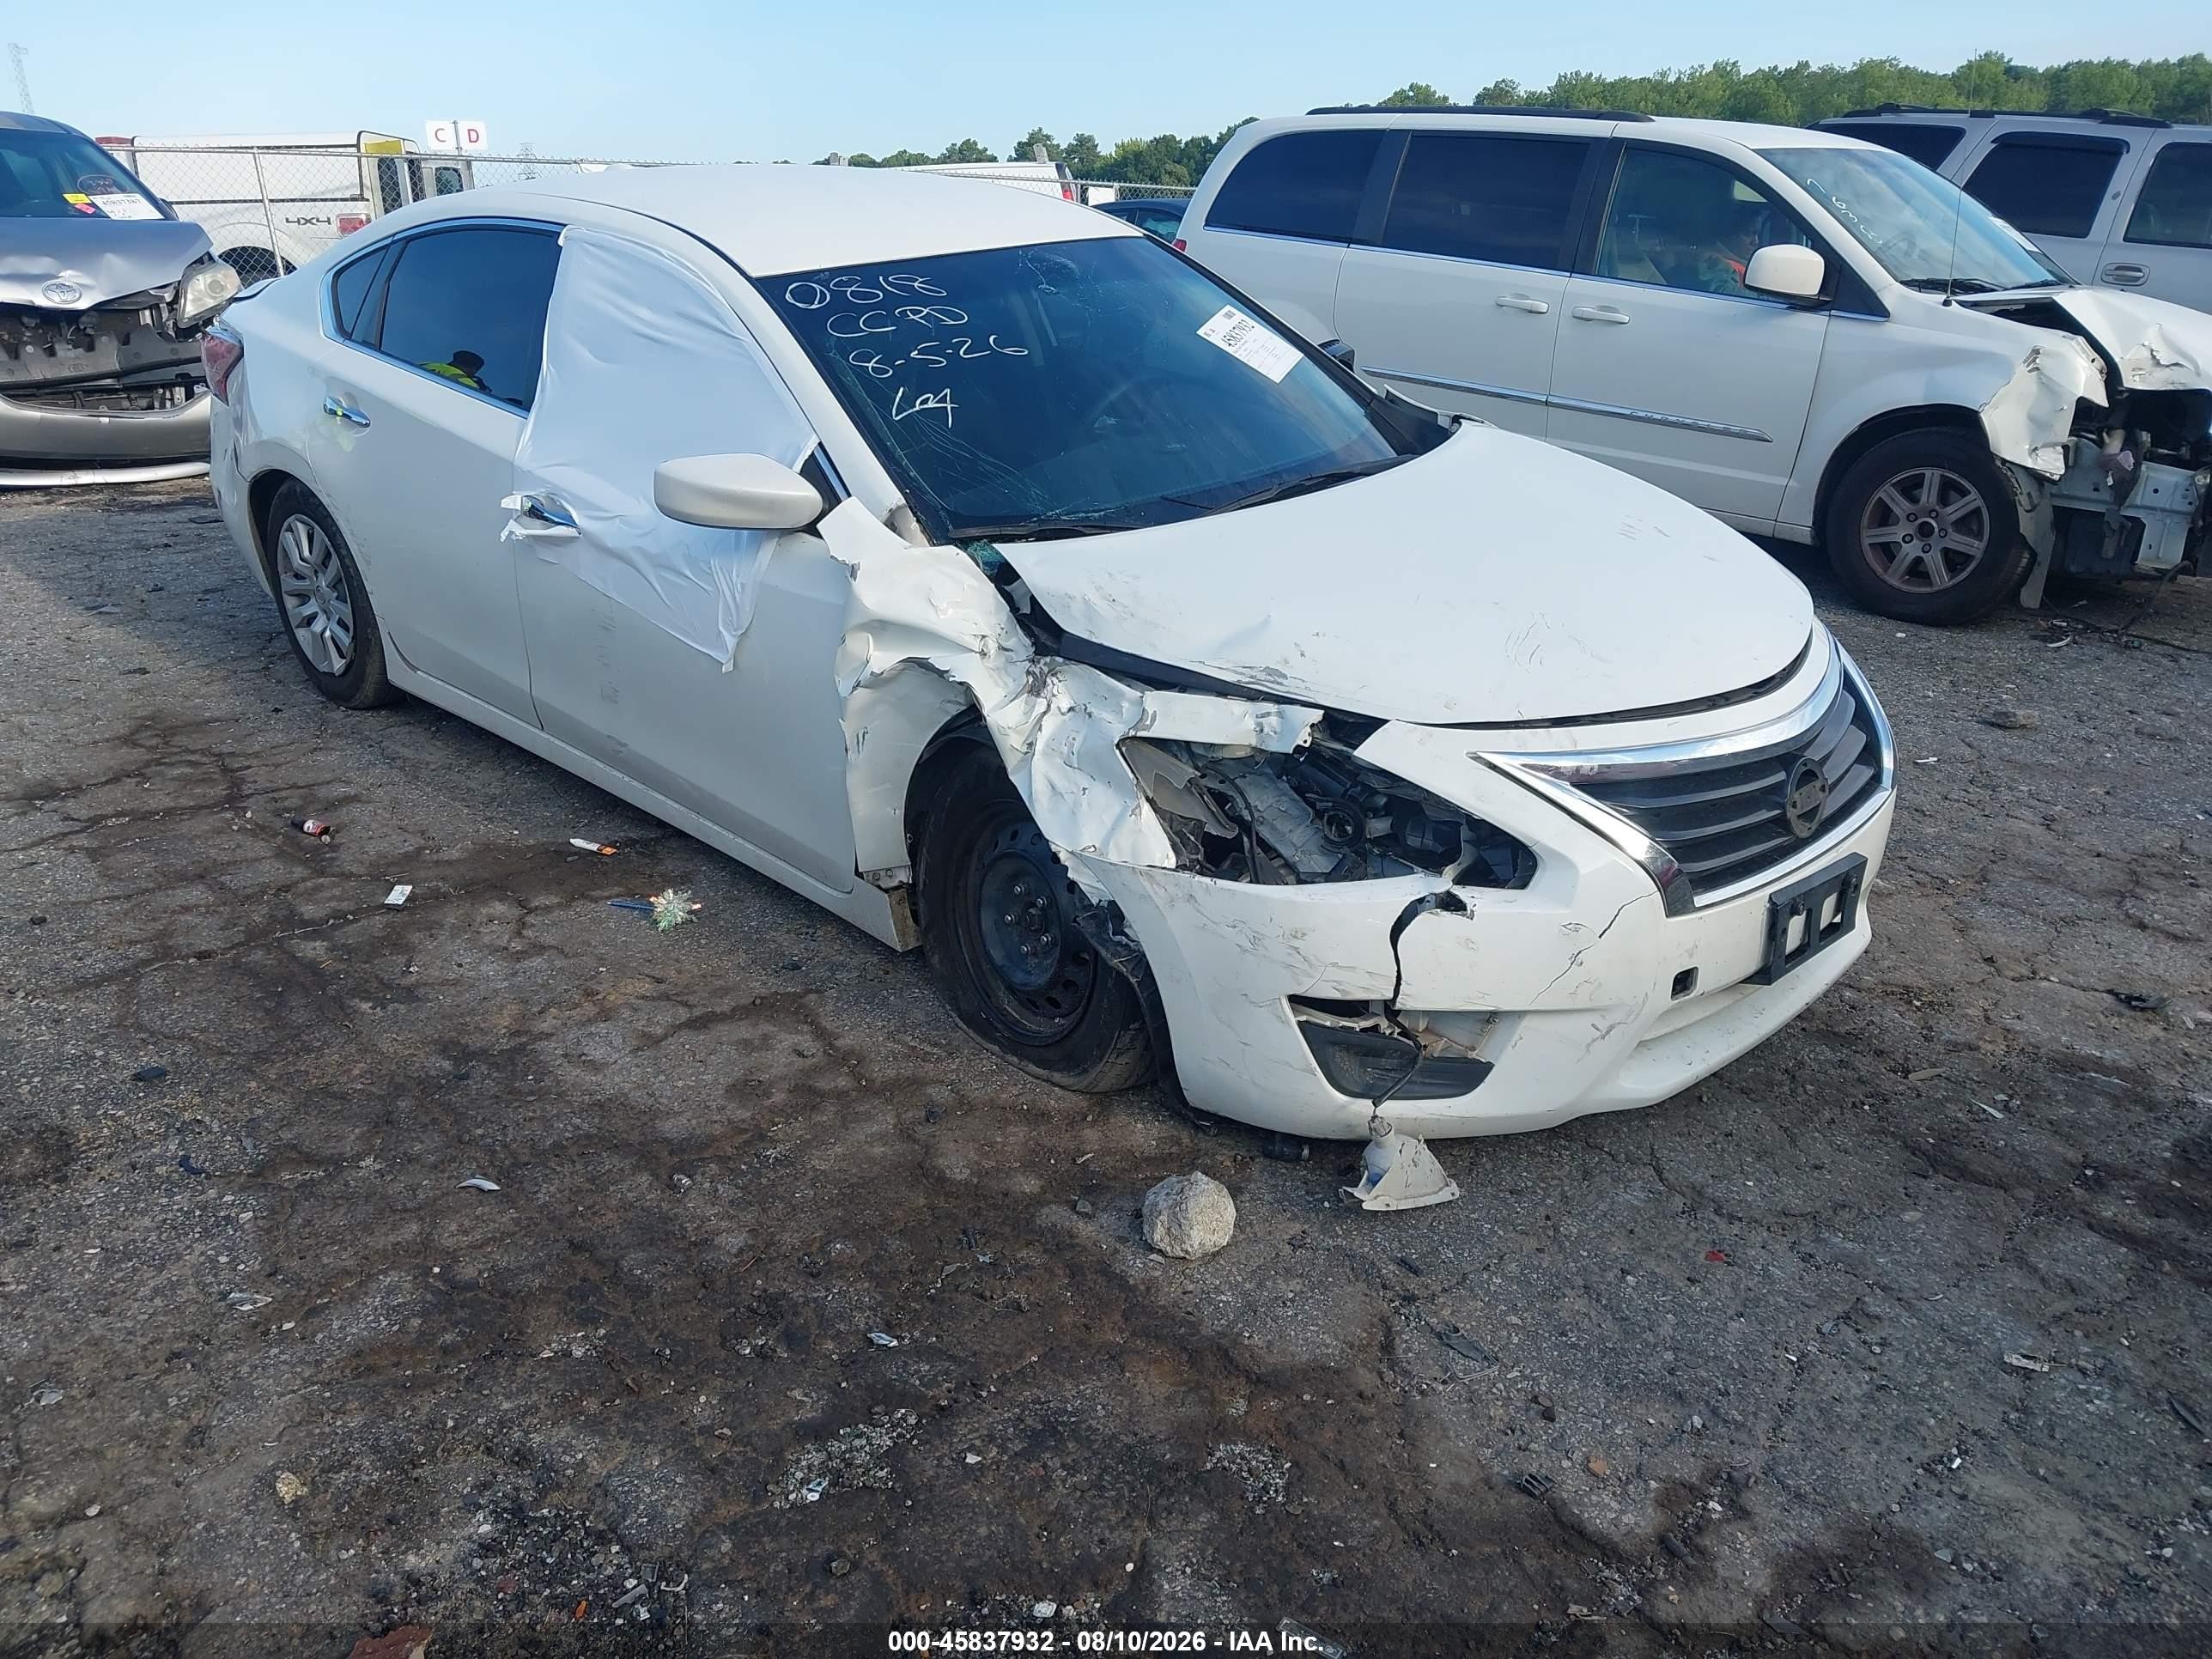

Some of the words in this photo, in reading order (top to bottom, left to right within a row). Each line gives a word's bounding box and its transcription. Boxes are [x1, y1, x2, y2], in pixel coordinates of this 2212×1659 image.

[434, 128, 447, 143] C
[467, 128, 479, 143] D
[785, 274, 947, 309] 0818
[827, 306, 969, 337] CCPD
[1220, 319, 1255, 348] 45837932
